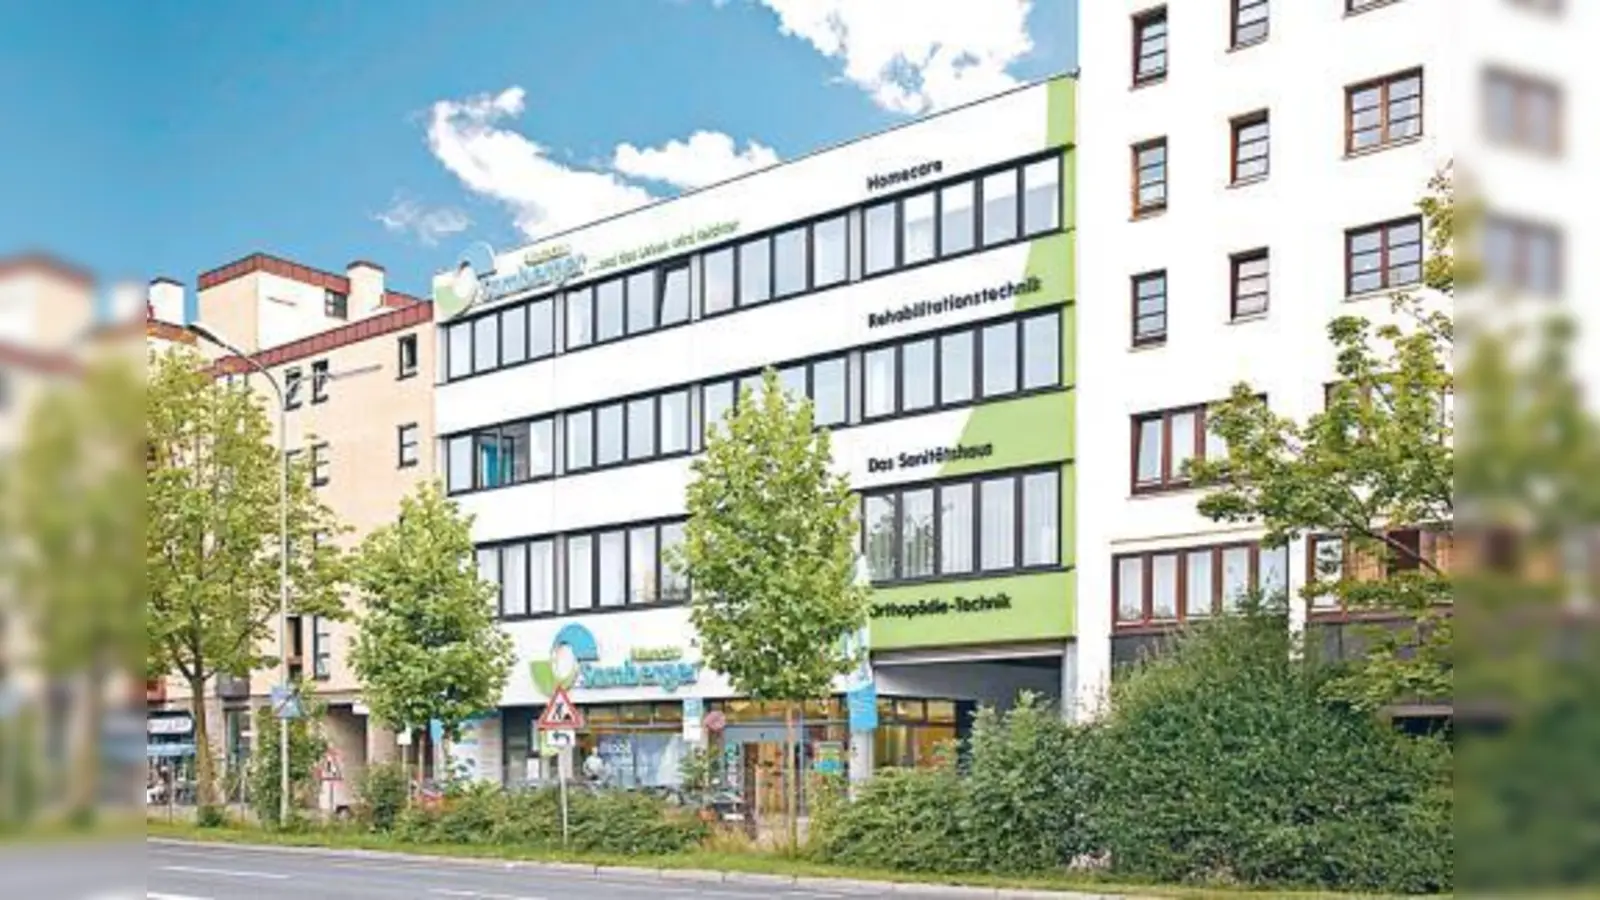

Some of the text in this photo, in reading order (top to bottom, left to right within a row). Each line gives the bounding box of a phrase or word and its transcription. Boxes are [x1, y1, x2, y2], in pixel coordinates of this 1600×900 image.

[866, 160, 944, 191] Homecare
[868, 277, 1042, 328] Rehabilitationstechnik
[868, 443, 993, 473] Das Sanitätshaus
[868, 594, 1013, 621] Orthopädie-Technik
